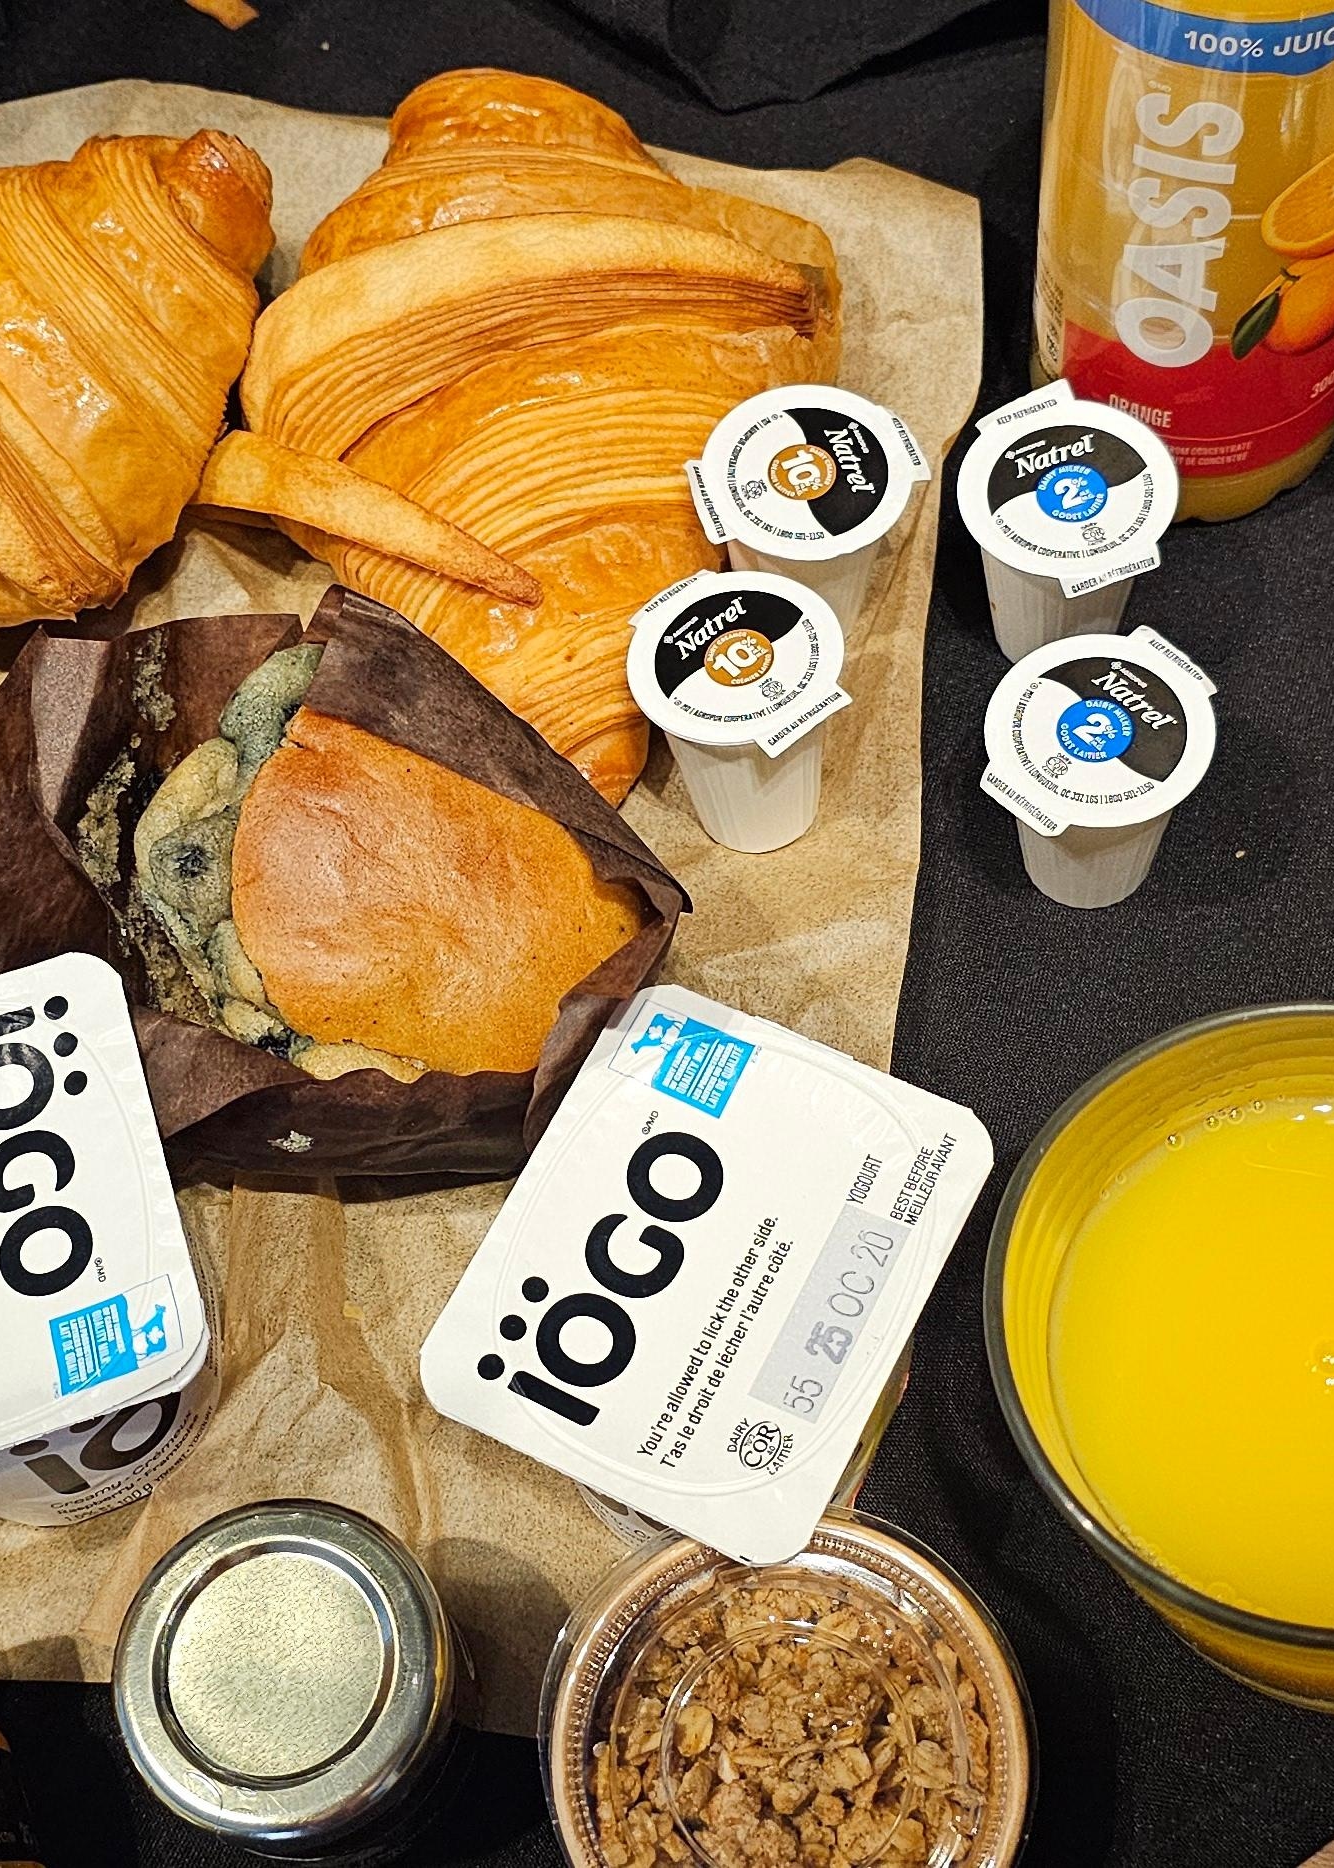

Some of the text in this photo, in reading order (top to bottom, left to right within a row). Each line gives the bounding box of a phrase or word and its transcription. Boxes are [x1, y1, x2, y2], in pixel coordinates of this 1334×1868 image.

[1184, 30, 1263, 58] 100%
[1114, 92, 1245, 368] OASIS
[822, 430, 874, 494] Natrel
[1015, 433, 1095, 479] Natrel
[676, 597, 747, 660] Natrel
[1090, 669, 1173, 731] Natrel
[985, 772, 1007, 793] GARDER
[1004, 787, 1016, 799] AU
[846, 1154, 882, 1204] YOGOURT
[890, 1146, 936, 1220] BEST BEFORE
[901, 1133, 956, 1225] MEILLEUR AVANT
[637, 1218, 778, 1456] You're allowed to lick the other side.
[779, 1223, 898, 1417] 55 25 OC 20
[660, 1241, 793, 1467] T'as le droit de lécher l'autre côté.
[727, 1418, 749, 1452] DAIRY
[50, 1481, 122, 1510] Creamy
